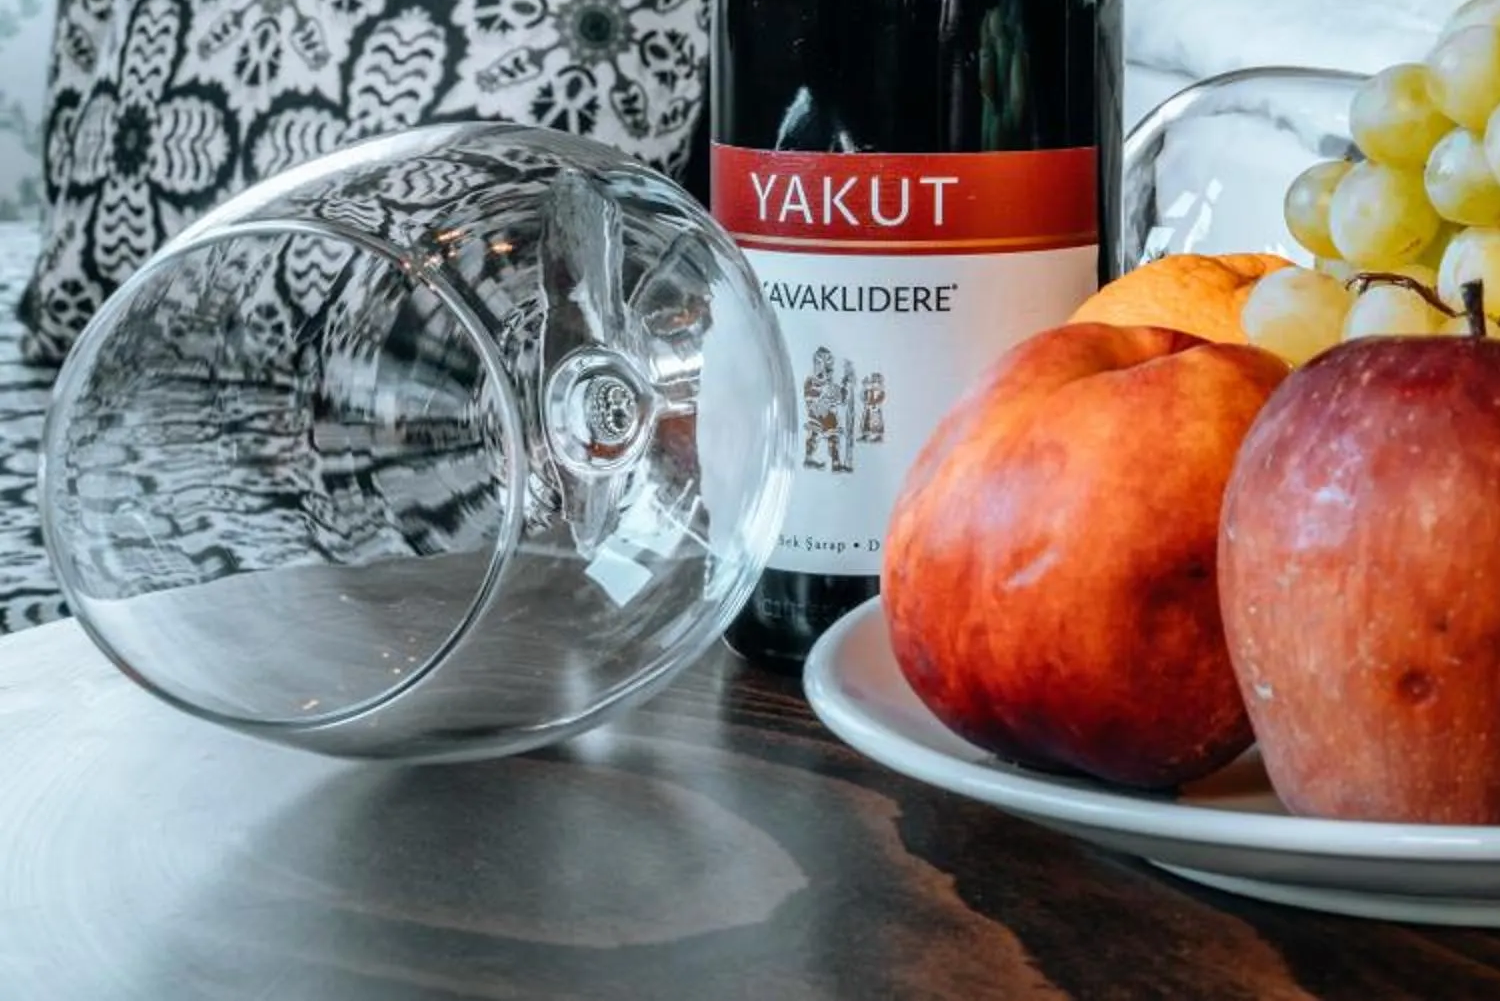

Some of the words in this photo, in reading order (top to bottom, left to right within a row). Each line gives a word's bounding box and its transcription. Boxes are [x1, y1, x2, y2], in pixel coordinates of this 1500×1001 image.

[750, 172, 960, 228] YAKUT
[763, 281, 953, 313] AVAKLIDERE
[805, 536, 846, 553] Şarap
